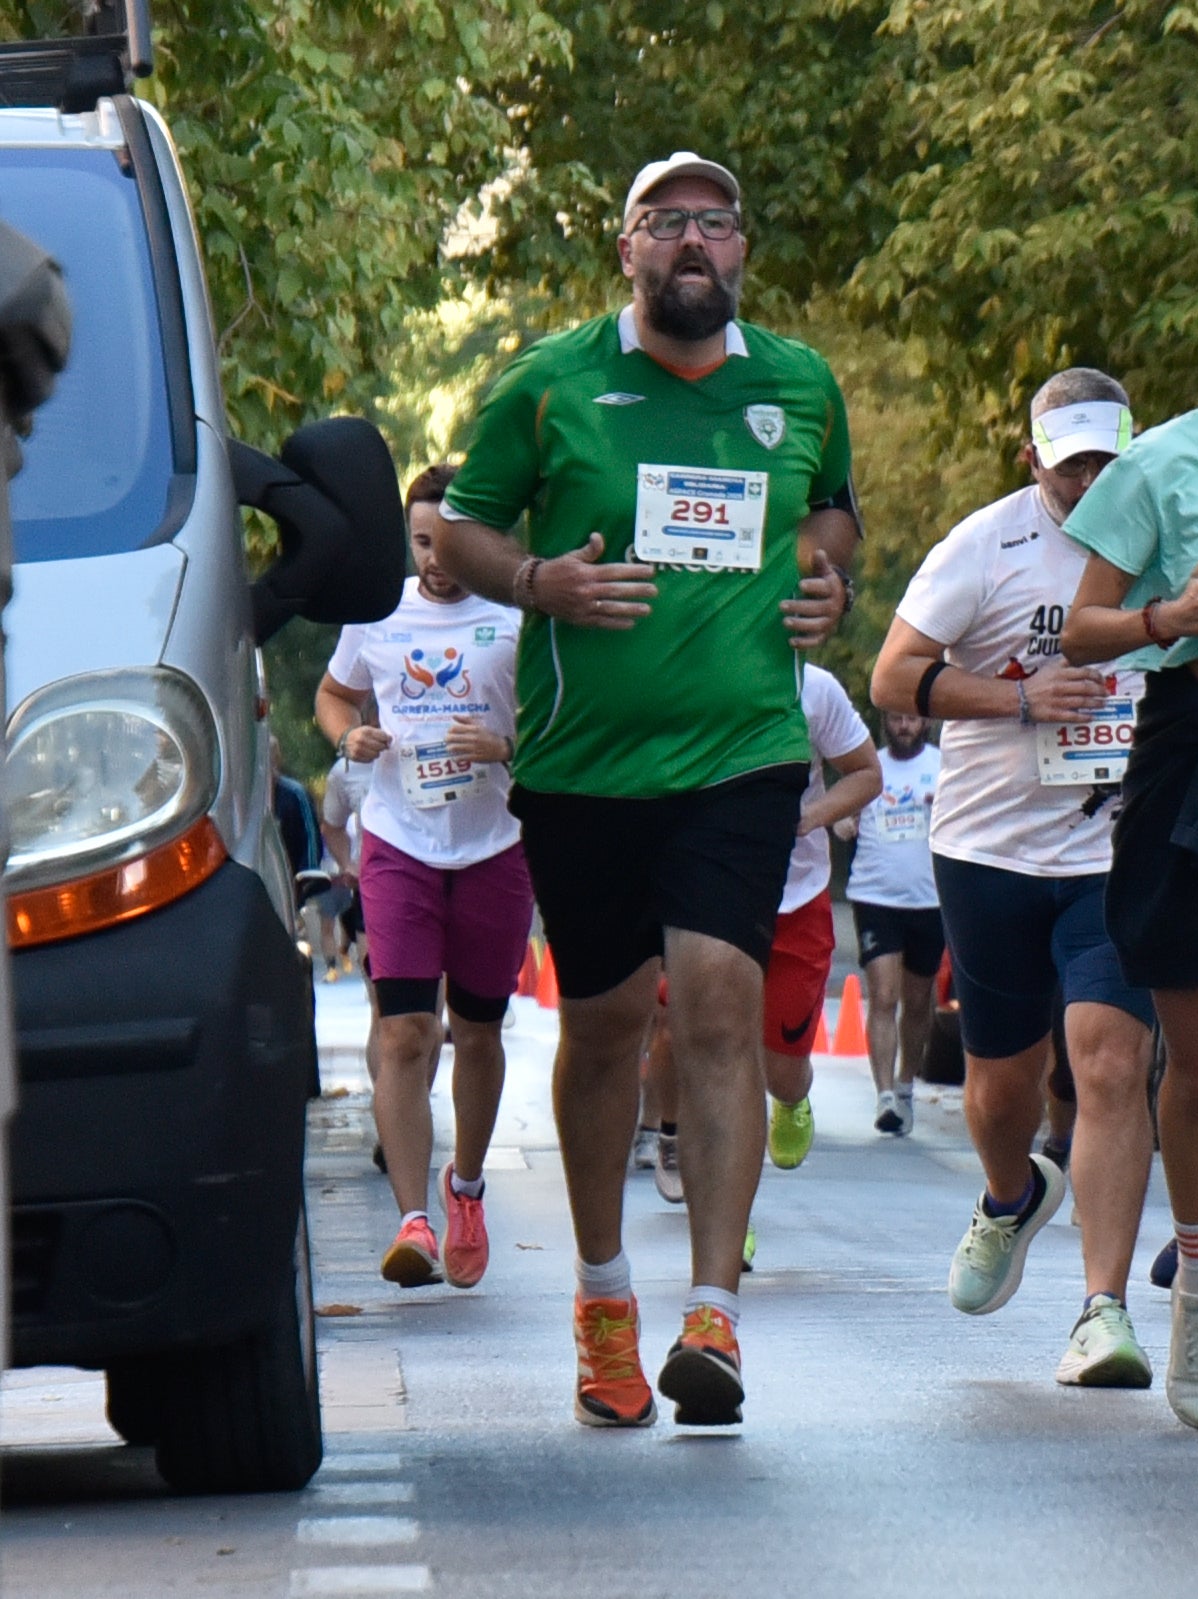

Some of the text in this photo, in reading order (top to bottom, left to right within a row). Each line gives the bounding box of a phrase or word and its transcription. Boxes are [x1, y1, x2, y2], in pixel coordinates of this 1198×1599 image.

[671, 500, 730, 525] 291
[1056, 724, 1136, 746] 1380
[417, 760, 472, 779] 1519
